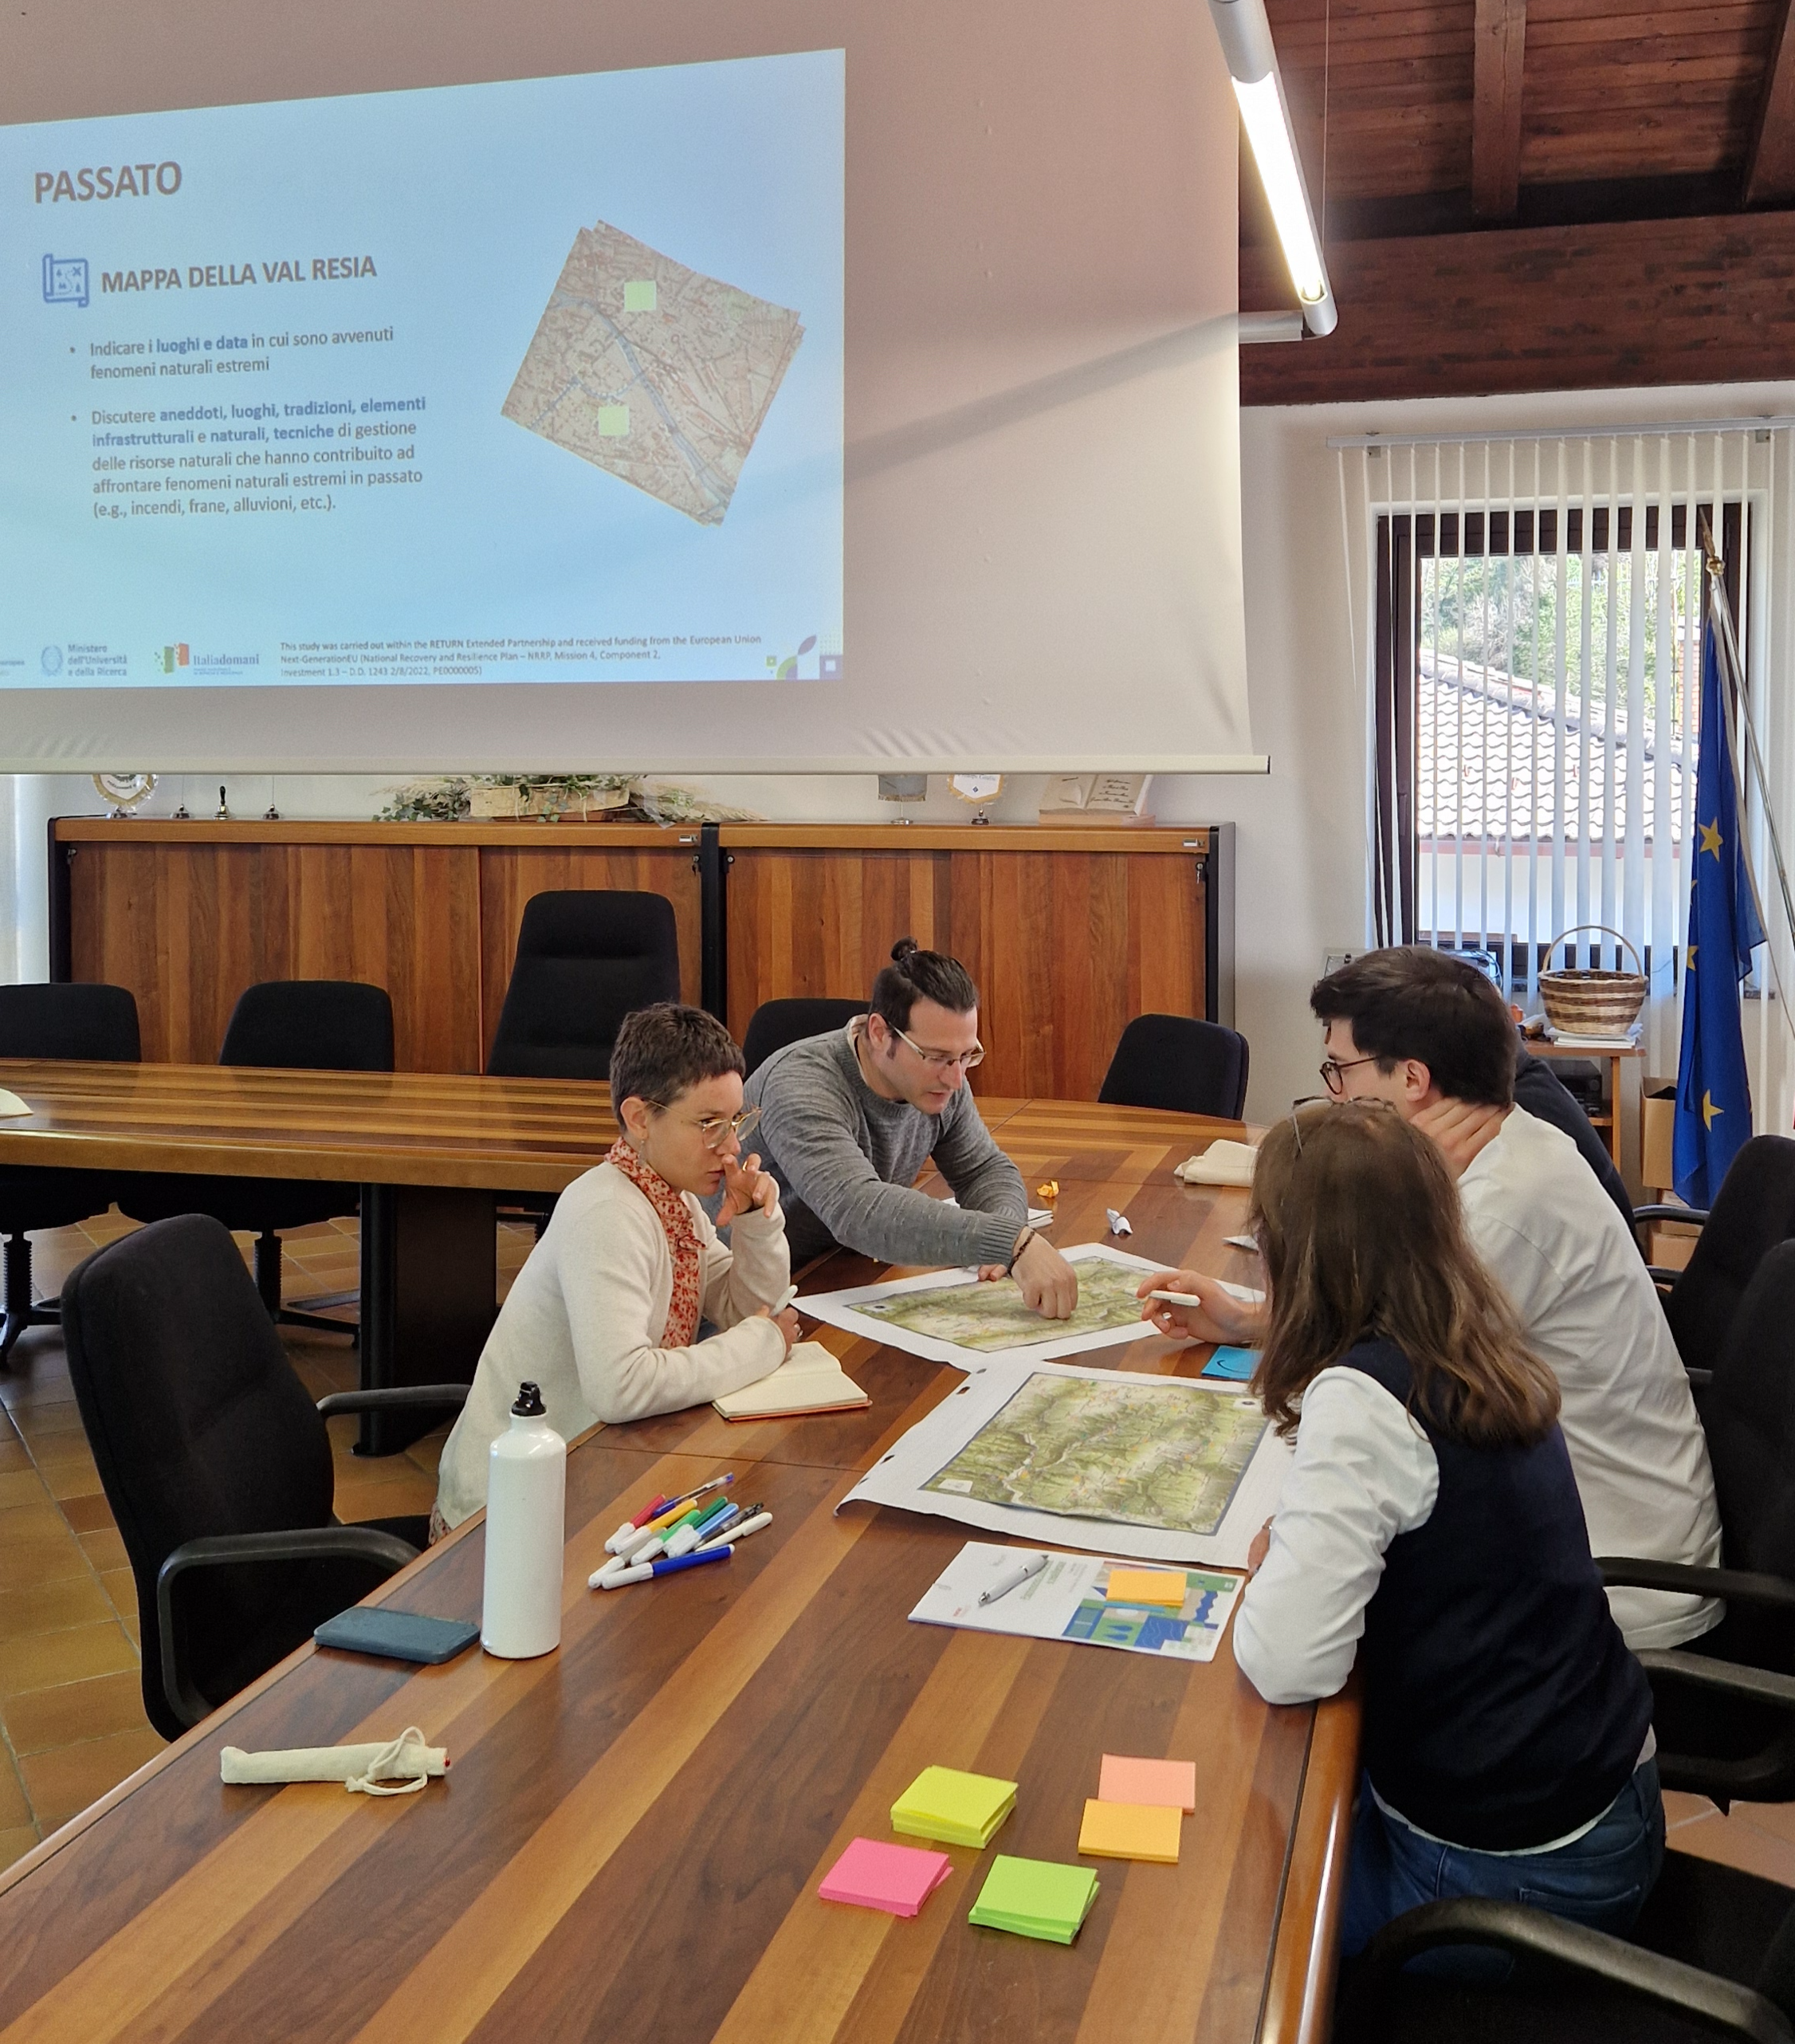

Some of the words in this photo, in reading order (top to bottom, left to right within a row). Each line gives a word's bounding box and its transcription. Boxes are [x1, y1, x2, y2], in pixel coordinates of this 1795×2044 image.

[35, 161, 182, 203] PASSATO
[102, 269, 182, 293] MAPPA
[189, 264, 257, 288] DELLA
[262, 261, 306, 283] VAL
[312, 256, 377, 280] RESIA
[90, 340, 145, 356] Indicare
[148, 339, 152, 353] i
[156, 337, 199, 355] luoghi
[203, 340, 212, 350] e
[216, 336, 248, 349] data
[252, 333, 265, 348] in
[269, 332, 289, 347] cui
[293, 333, 328, 346] sono
[332, 326, 393, 344] avvenuti
[91, 362, 155, 379] fenomeni
[160, 360, 212, 375] naturali
[217, 356, 269, 373] estremi
[92, 410, 155, 424] Discutere
[160, 406, 227, 421] aneddoti,
[231, 403, 279, 420] luoghi,
[284, 400, 356, 416] tradizioni,
[360, 396, 426, 413] elementi
[92, 430, 194, 446] infrastrutturali
[198, 433, 206, 442] e
[210, 426, 269, 442] naturali,
[273, 424, 334, 439] tecniche
[338, 423, 351, 437] di
[355, 421, 416, 439] gestione
[92, 456, 126, 471] delle
[130, 455, 175, 469] risorse
[179, 452, 231, 467] naturali
[236, 451, 261, 466] che
[265, 450, 309, 464] hanno
[313, 446, 393, 462] contribuito
[397, 444, 414, 459] ad
[93, 478, 161, 493] affrontare
[165, 474, 231, 491] fenomeni
[236, 473, 289, 489] naturali
[293, 470, 346, 486] estremi
[351, 470, 363, 484] in
[367, 470, 422, 486] passato
[94, 502, 127, 519] (e.g.,
[132, 499, 185, 516] incendi,
[189, 498, 230, 514] frane,
[234, 495, 297, 513] alluvioni,
[300, 494, 336, 512] etc.).
[68, 644, 108, 653] Ministero
[299, 642, 320, 651] study
[340, 641, 368, 650] carried
[430, 639, 463, 648] RETURN
[466, 639, 505, 648] Extended
[508, 639, 556, 648] Partnership
[558, 638, 574, 647] and
[576, 637, 612, 647] received
[615, 637, 647, 647] funding
[650, 636, 670, 645] from
[673, 636, 687, 645] the
[690, 635, 732, 645] European
[734, 635, 761, 644] Union
[194, 654, 259, 665] Italiadomani
[360, 654, 397, 663] (National
[400, 654, 437, 662] Recovery
[439, 653, 454, 662] and
[528, 651, 552, 660] NRRP,
[555, 651, 587, 660] Mission
[590, 651, 597, 660] 4,
[600, 651, 650, 660] Component
[653, 650, 661, 659] 2,
[75, 667, 95, 677] della
[97, 666, 128, 676] Ricerca
